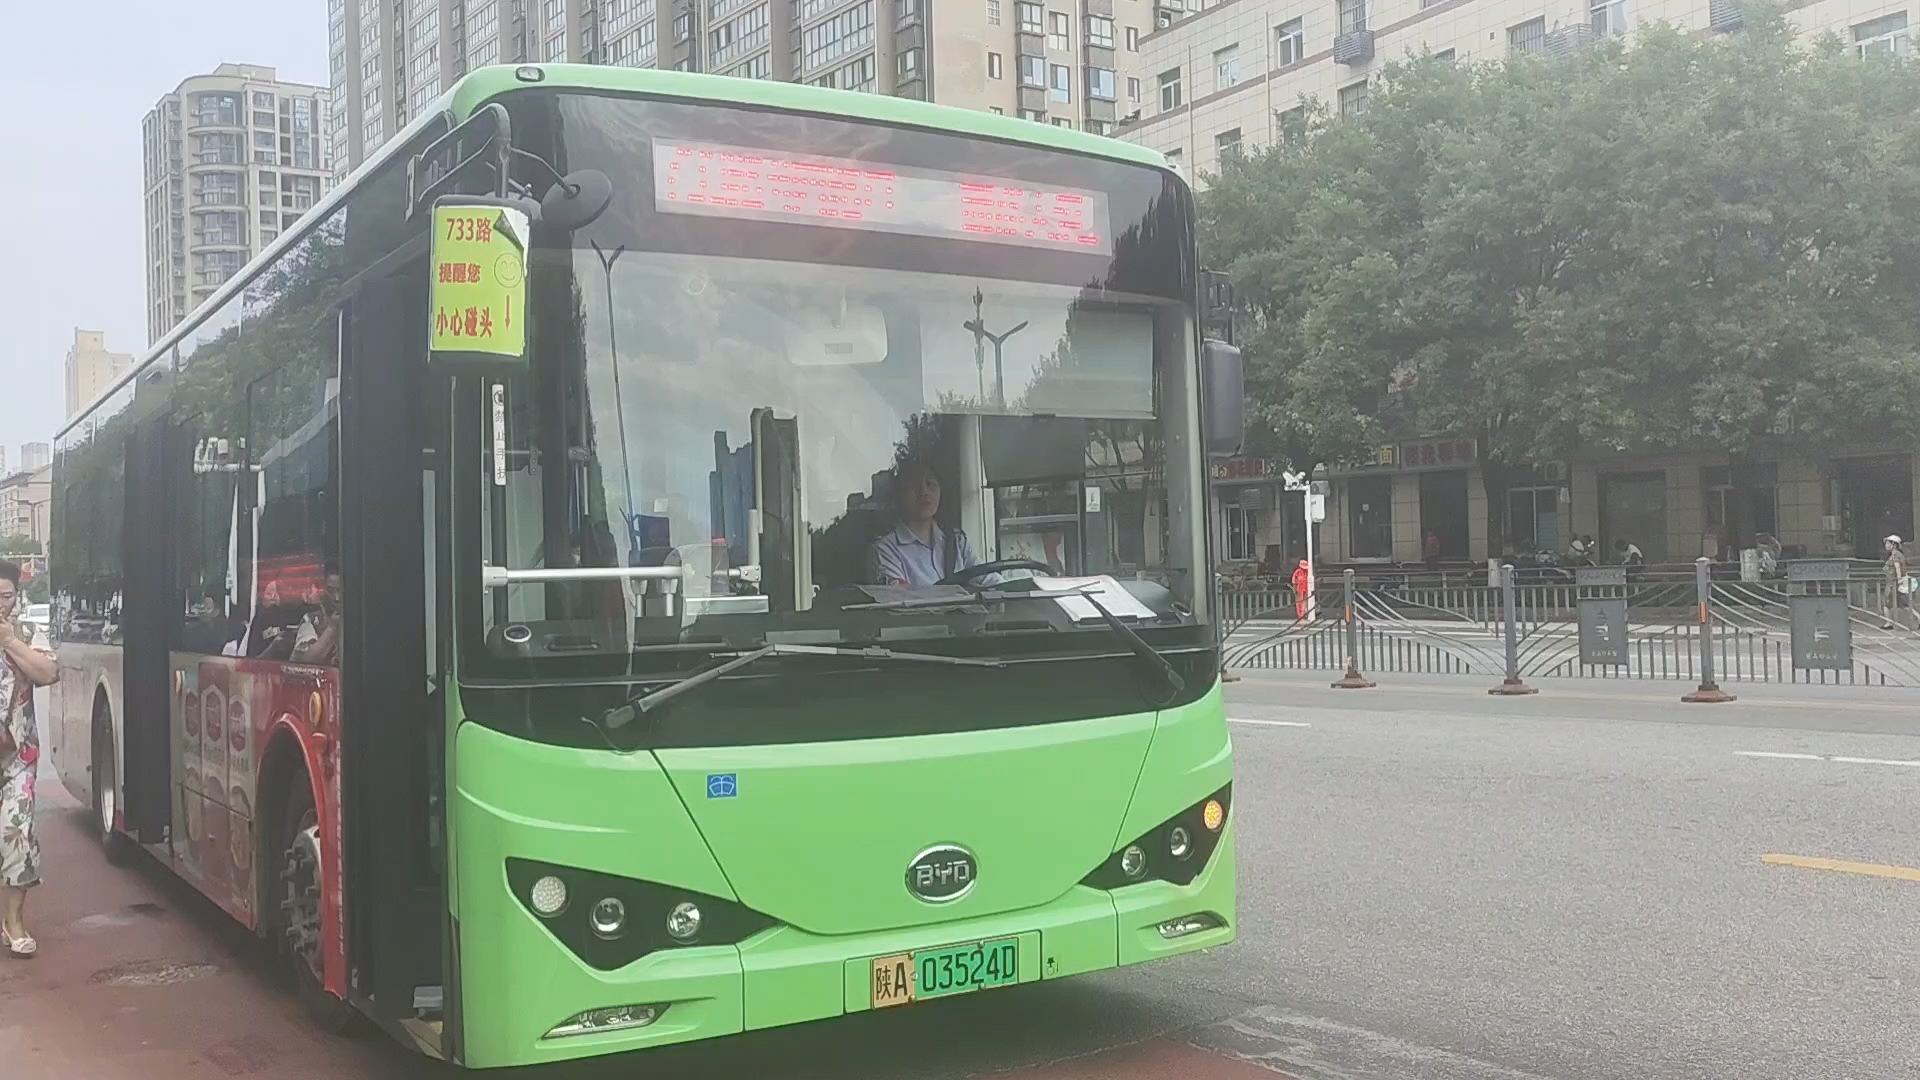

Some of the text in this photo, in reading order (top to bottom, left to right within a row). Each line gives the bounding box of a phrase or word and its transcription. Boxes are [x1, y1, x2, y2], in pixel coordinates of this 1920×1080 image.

[446, 217, 492, 243] 733路
[438, 263, 481, 283] 提醒您
[436, 306, 493, 338] 小心碰头
[915, 859, 970, 888] BYD
[876, 946, 1016, 1000] 陕A 03524D
